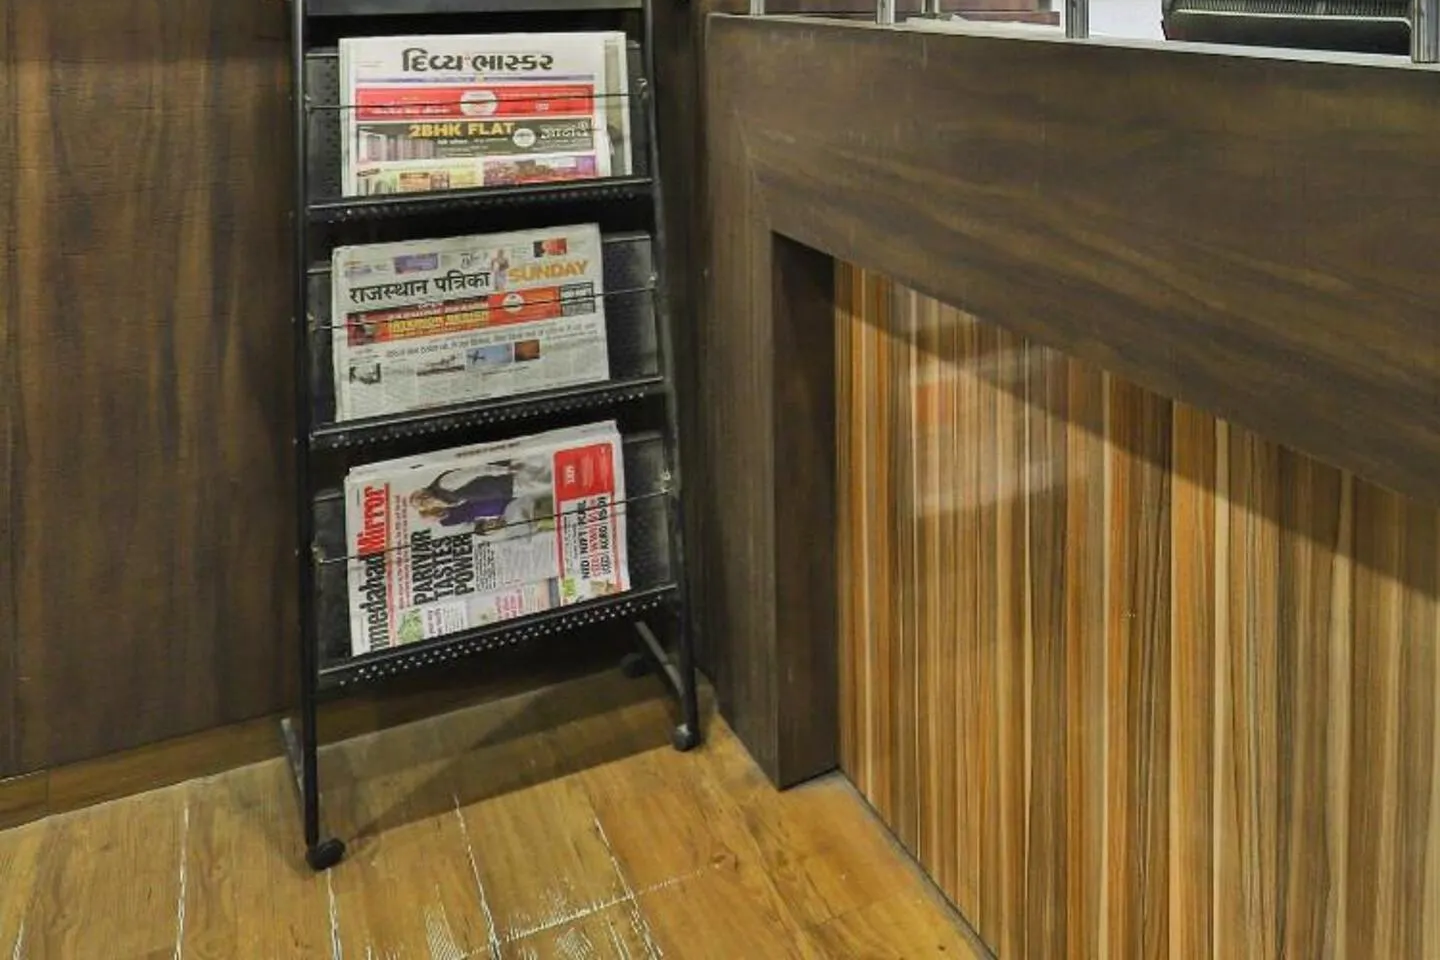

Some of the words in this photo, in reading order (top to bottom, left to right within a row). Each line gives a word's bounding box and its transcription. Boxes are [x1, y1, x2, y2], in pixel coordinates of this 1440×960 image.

[471, 54, 555, 73] ભાસ્કર
[408, 123, 462, 138] 2BHK
[467, 122, 516, 137] FLAT
[349, 279, 430, 305] राजस्थान
[433, 269, 491, 294] पत्रिका
[508, 259, 589, 284] SUNDAY
[357, 484, 386, 558] Mirror
[410, 528, 435, 606] PARIVAR
[430, 536, 455, 602] TASTES
[452, 534, 476, 596] POWER
